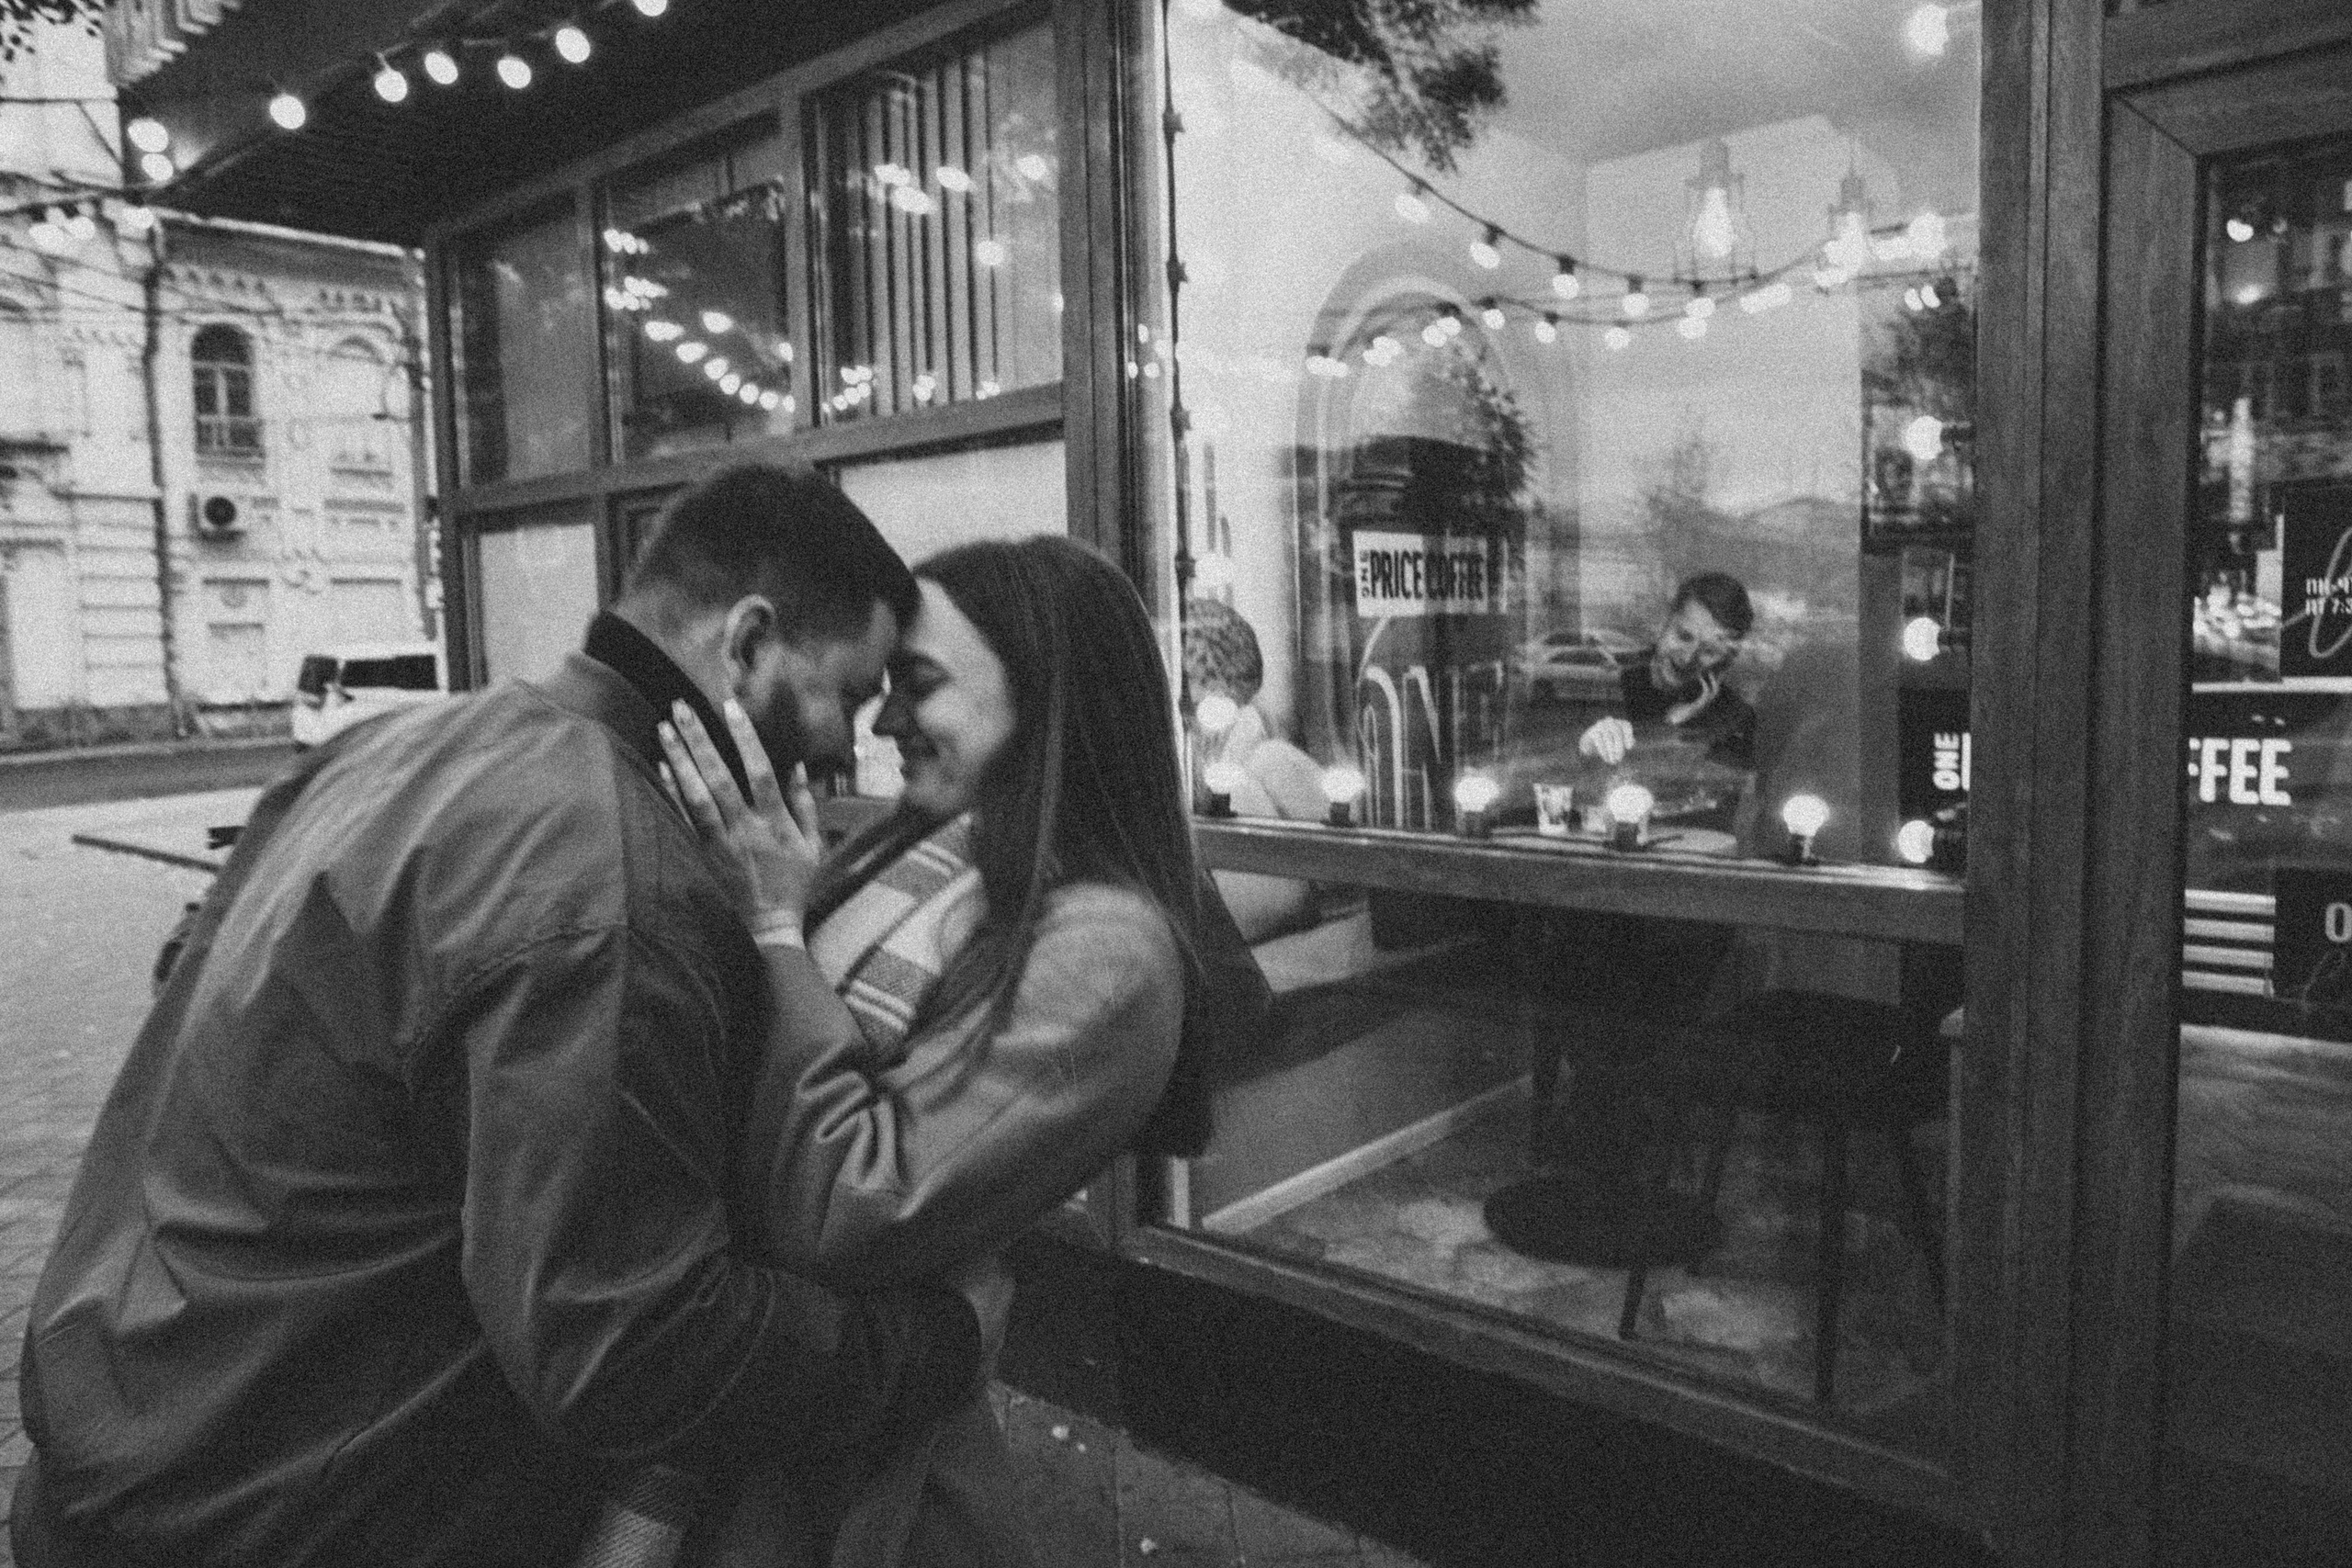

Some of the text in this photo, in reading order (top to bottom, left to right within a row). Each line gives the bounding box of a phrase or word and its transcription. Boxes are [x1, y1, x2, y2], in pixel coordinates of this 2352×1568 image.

[1371, 550, 1424, 600] PRICE
[1425, 553, 1485, 601] COFFEE
[2306, 577, 2352, 595] ПН-Ч
[1932, 732, 1959, 790] ONE
